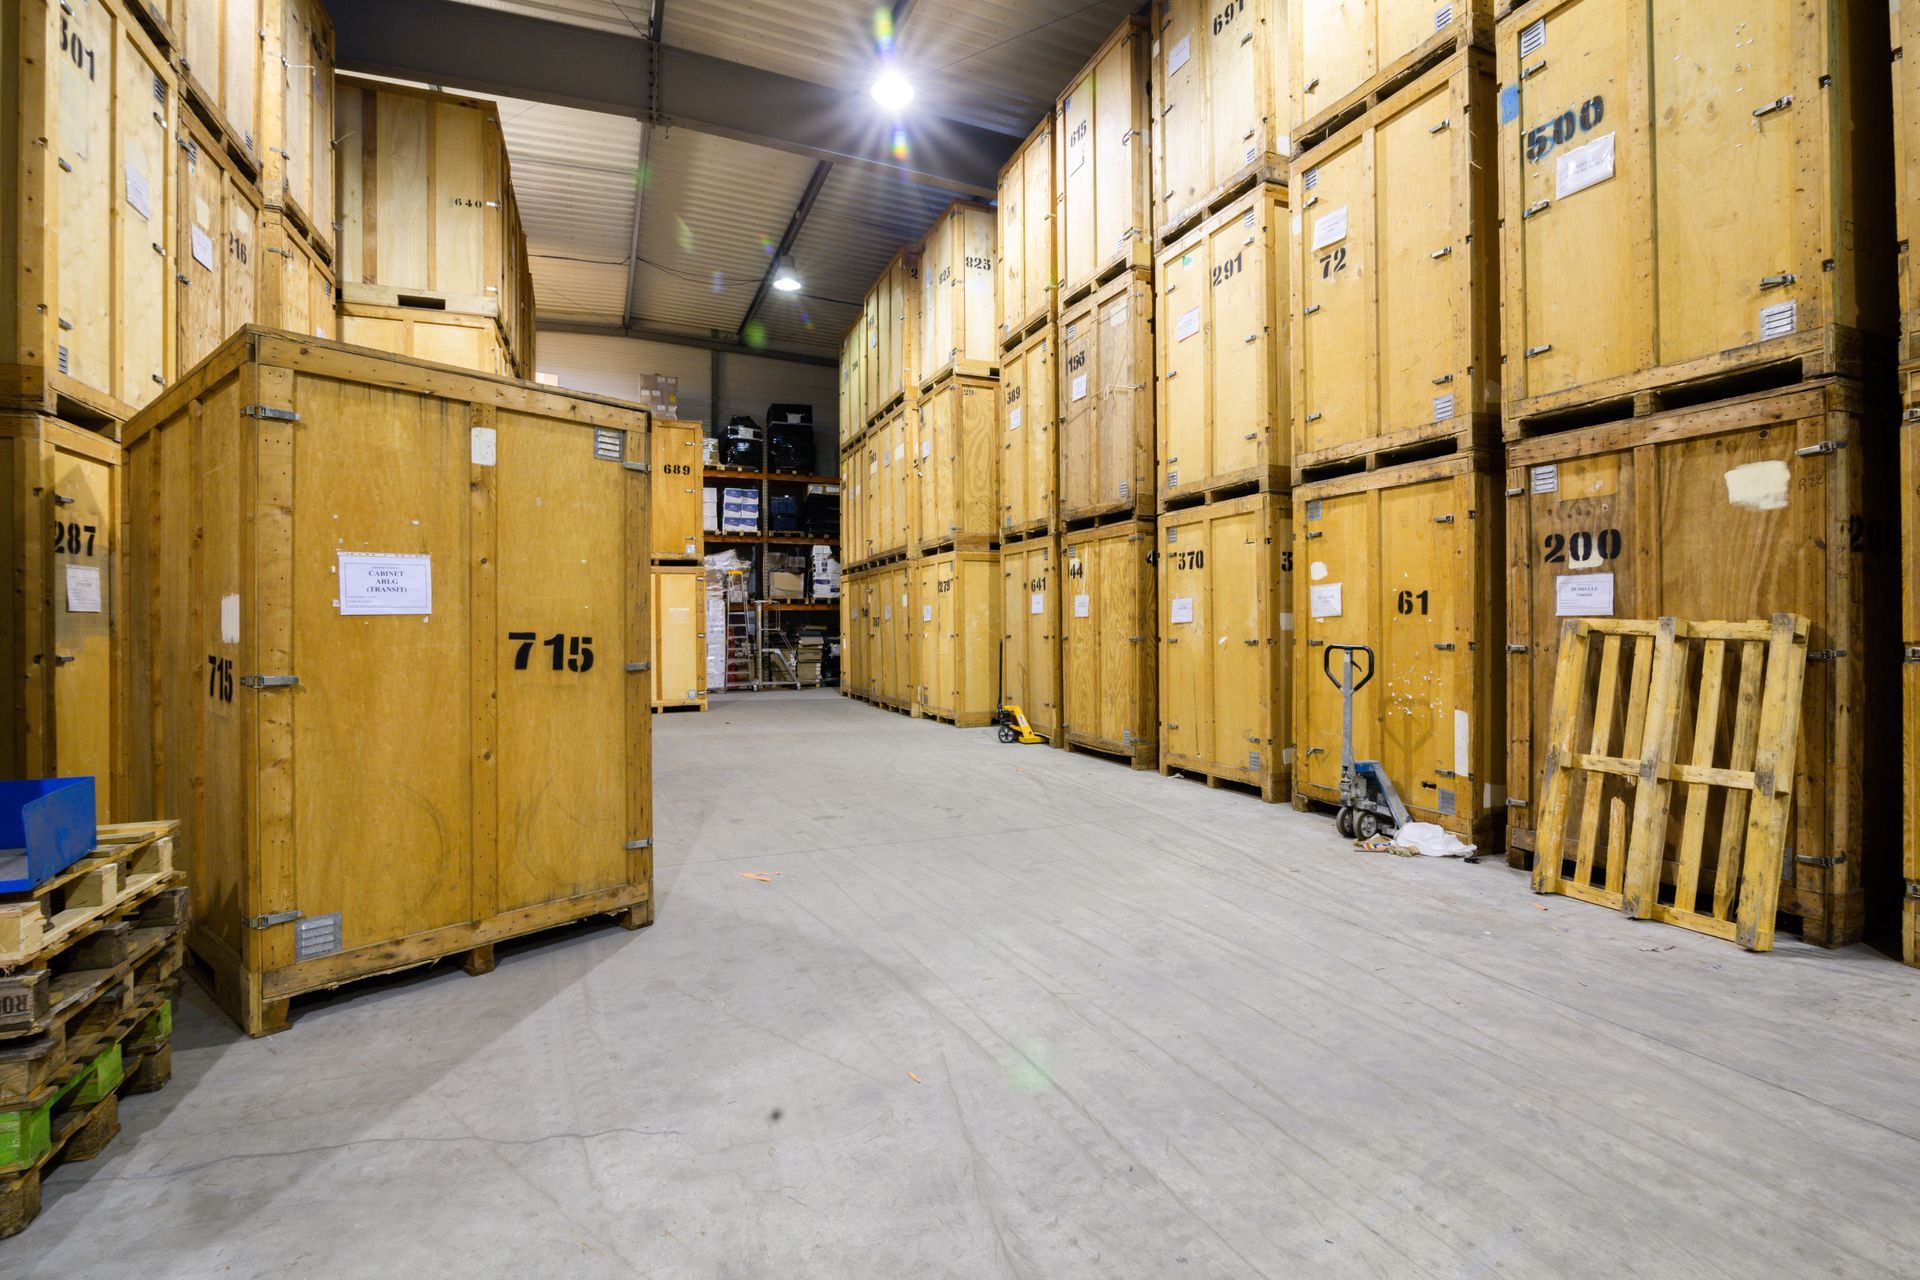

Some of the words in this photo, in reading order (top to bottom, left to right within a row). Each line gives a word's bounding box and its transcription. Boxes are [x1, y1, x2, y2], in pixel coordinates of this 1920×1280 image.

[1526, 95, 1604, 164] 500
[454, 197, 482, 208] 640
[1212, 251, 1242, 288] 291
[1319, 247, 1346, 280] 72
[663, 463, 690, 475] 689
[55, 520, 96, 557] 287
[1544, 528, 1622, 564] 200
[1178, 550, 1204, 570] 370
[1030, 576, 1046, 593] 641
[1397, 590, 1429, 615] 61
[507, 632, 594, 672] 715
[208, 655, 233, 704] 715
